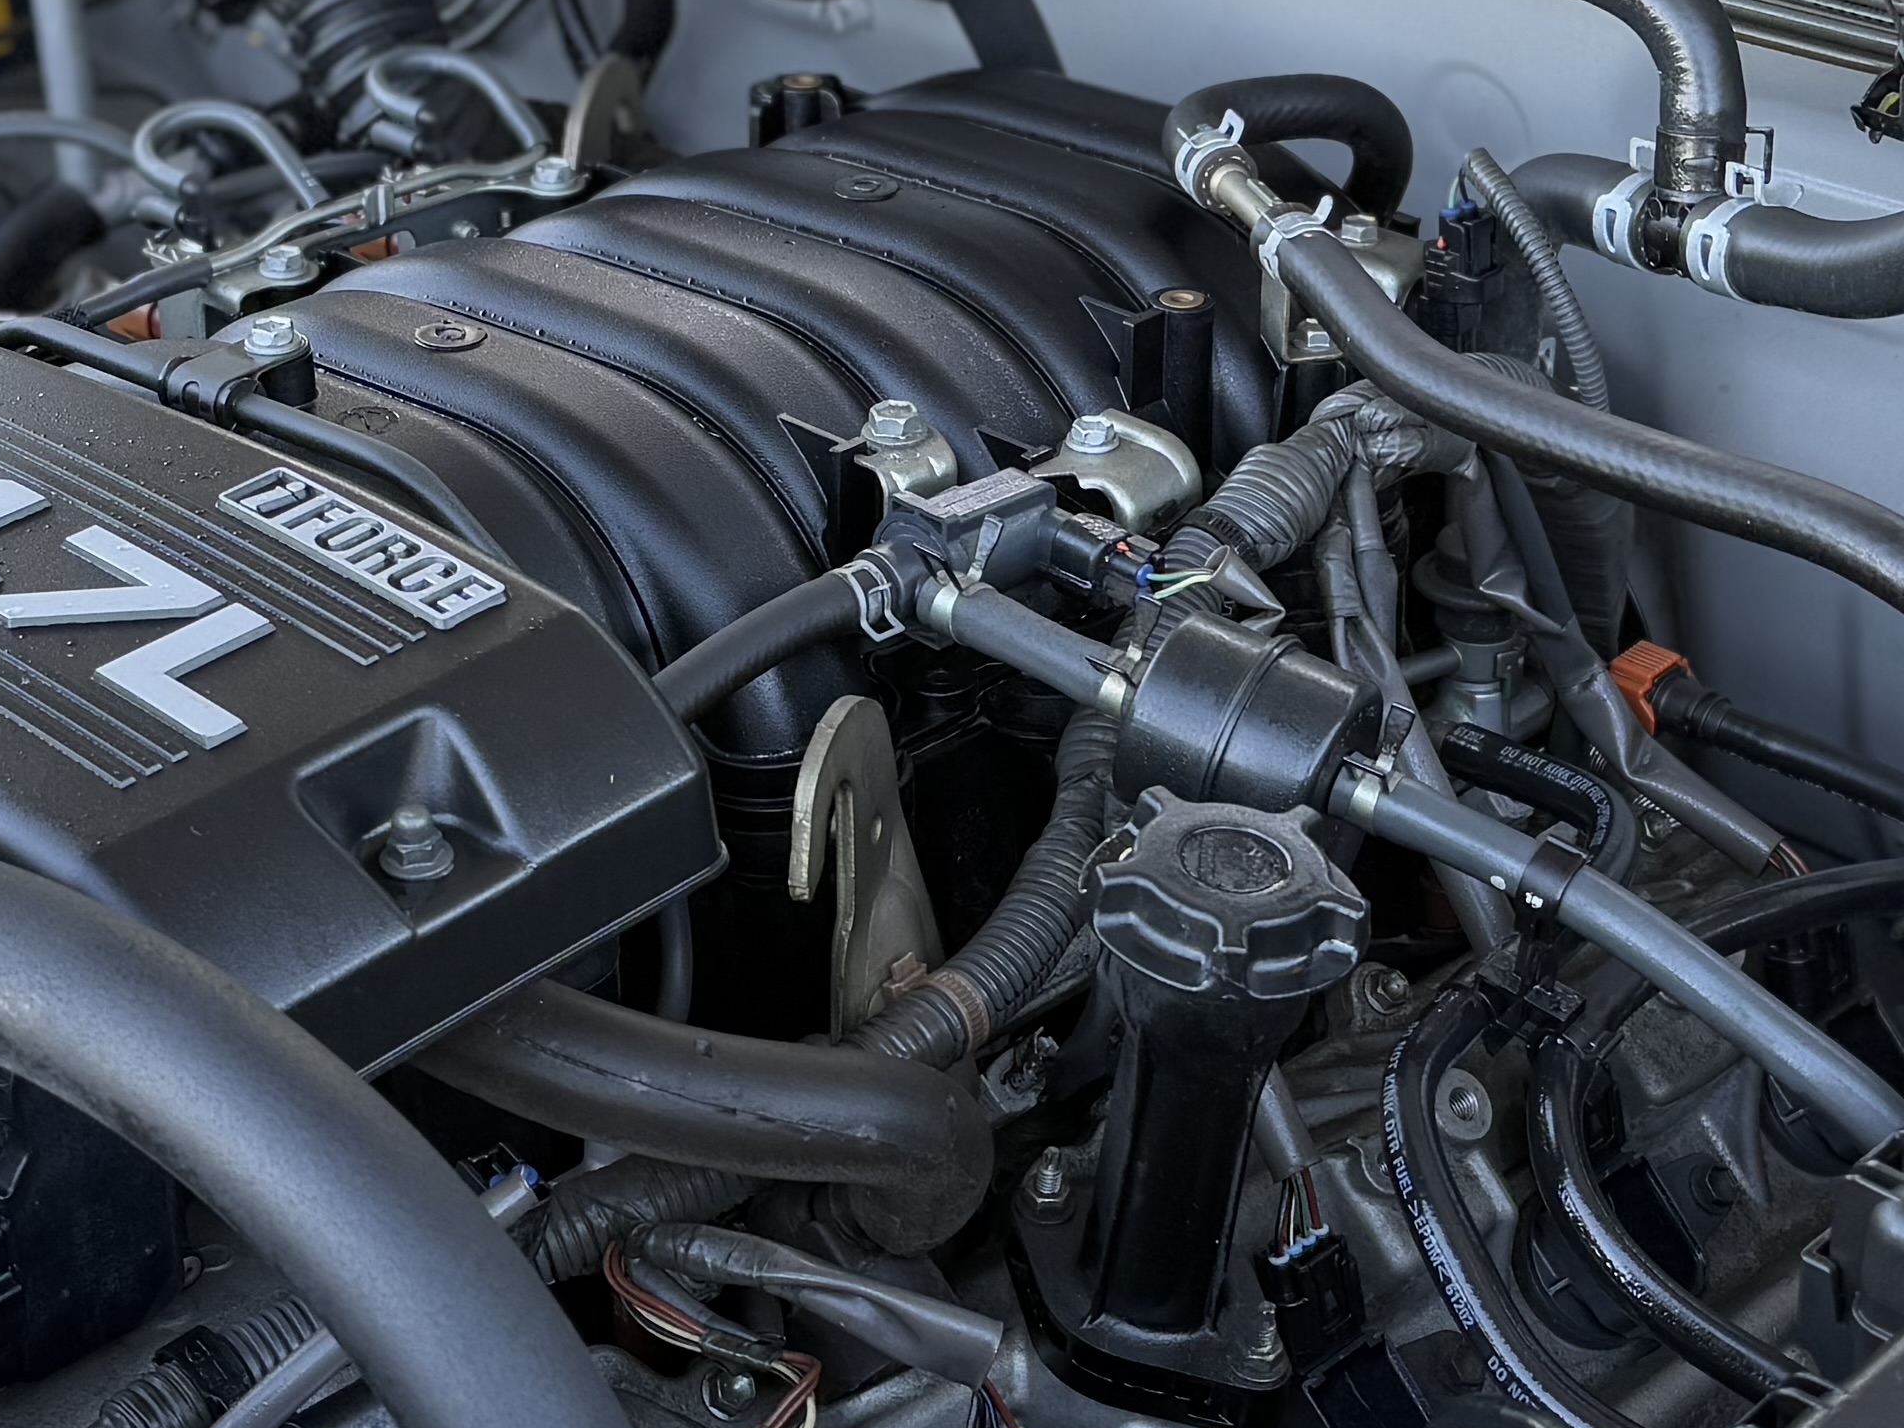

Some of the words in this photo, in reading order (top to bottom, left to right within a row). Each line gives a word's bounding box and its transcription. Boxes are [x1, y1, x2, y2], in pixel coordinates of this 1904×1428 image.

[1520, 752, 1547, 768] NOT
[1545, 762, 1574, 782] KINK
[1383, 1073, 1397, 1116] KINK
[1385, 1119, 1400, 1154] DTR
[1393, 1156, 1414, 1199] FUEL
[1445, 1284, 1474, 1330] 61202
[1488, 1355, 1508, 1382] DO
